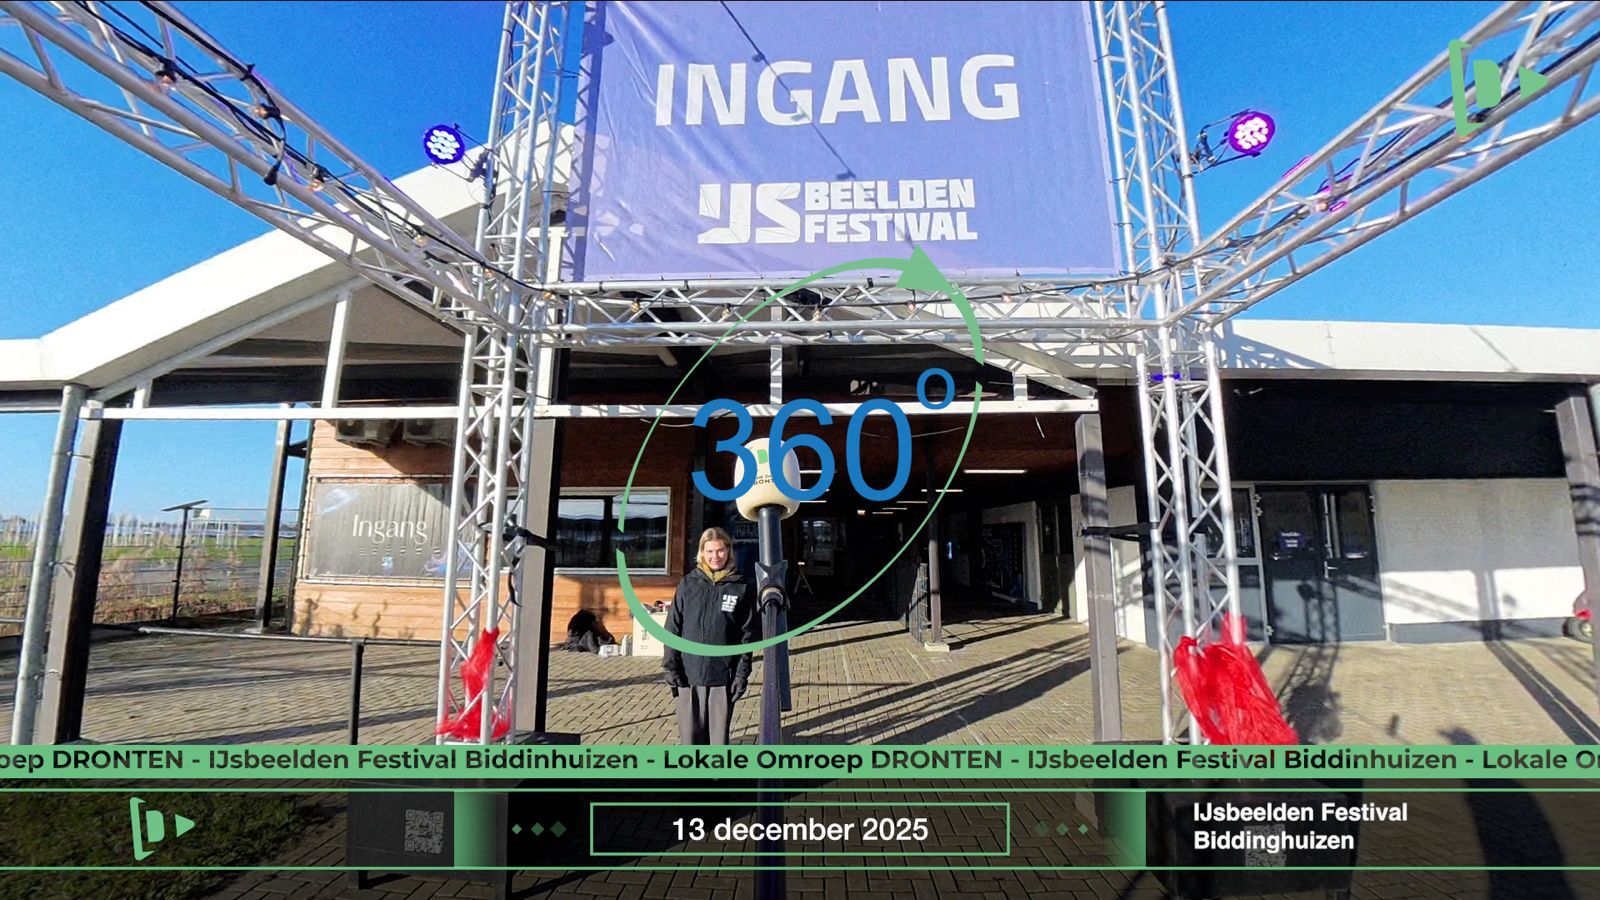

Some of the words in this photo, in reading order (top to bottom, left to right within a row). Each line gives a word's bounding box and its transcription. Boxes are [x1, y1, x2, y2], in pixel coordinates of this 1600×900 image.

[655, 54, 1020, 126] INGANG
[804, 178, 976, 211] BEELDEN
[804, 211, 978, 243] FESTIVAL
[352, 514, 428, 545] Ingang
